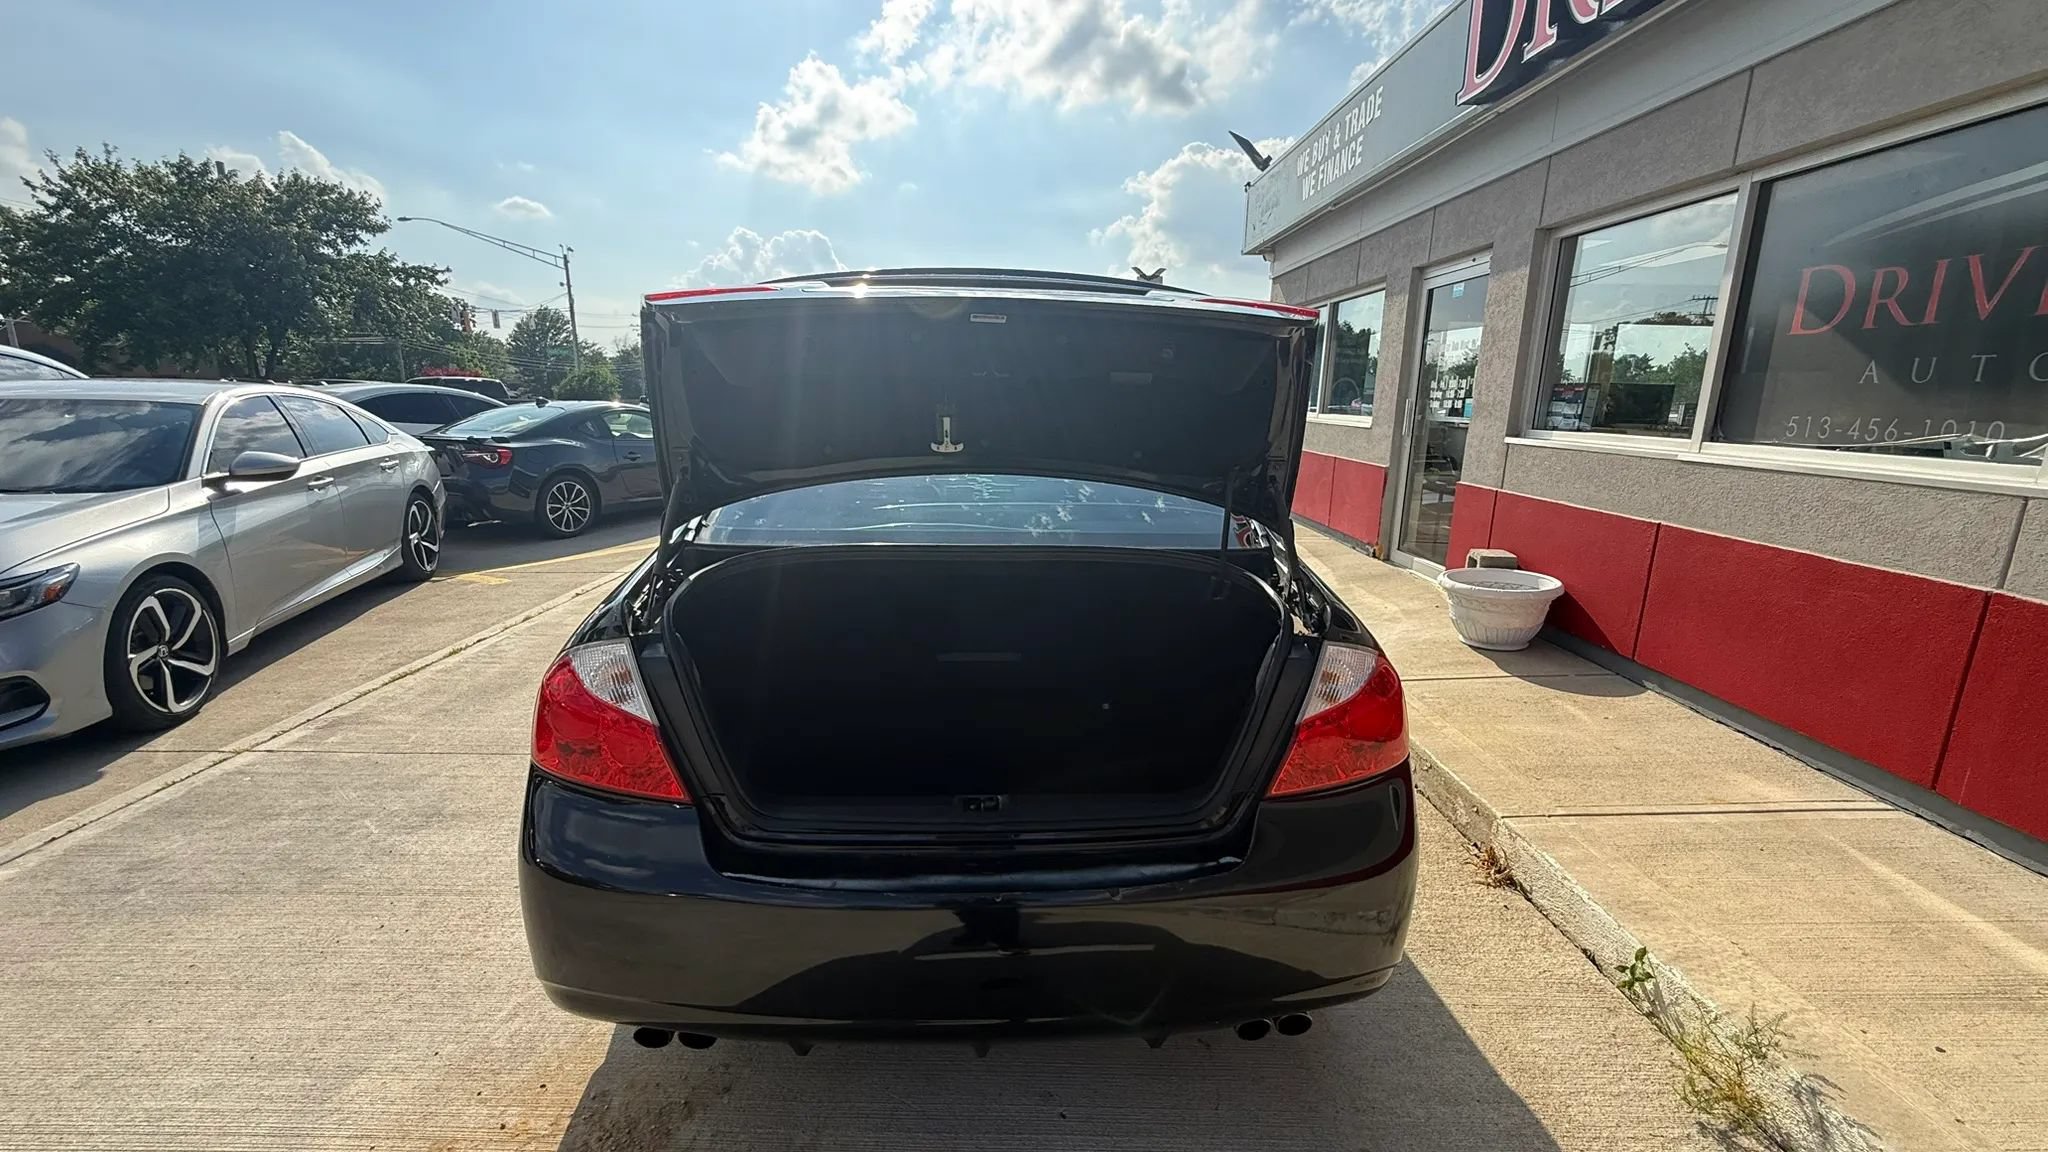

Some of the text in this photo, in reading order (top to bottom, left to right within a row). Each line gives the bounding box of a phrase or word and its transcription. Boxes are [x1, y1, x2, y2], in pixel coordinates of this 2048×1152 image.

[1297, 85, 1384, 177] WE BUY & TRADE
[1302, 134, 1364, 201] WE FINANCE
[1786, 245, 2048, 335] DRIV
[1785, 415, 2005, 443] 513-456-1010
